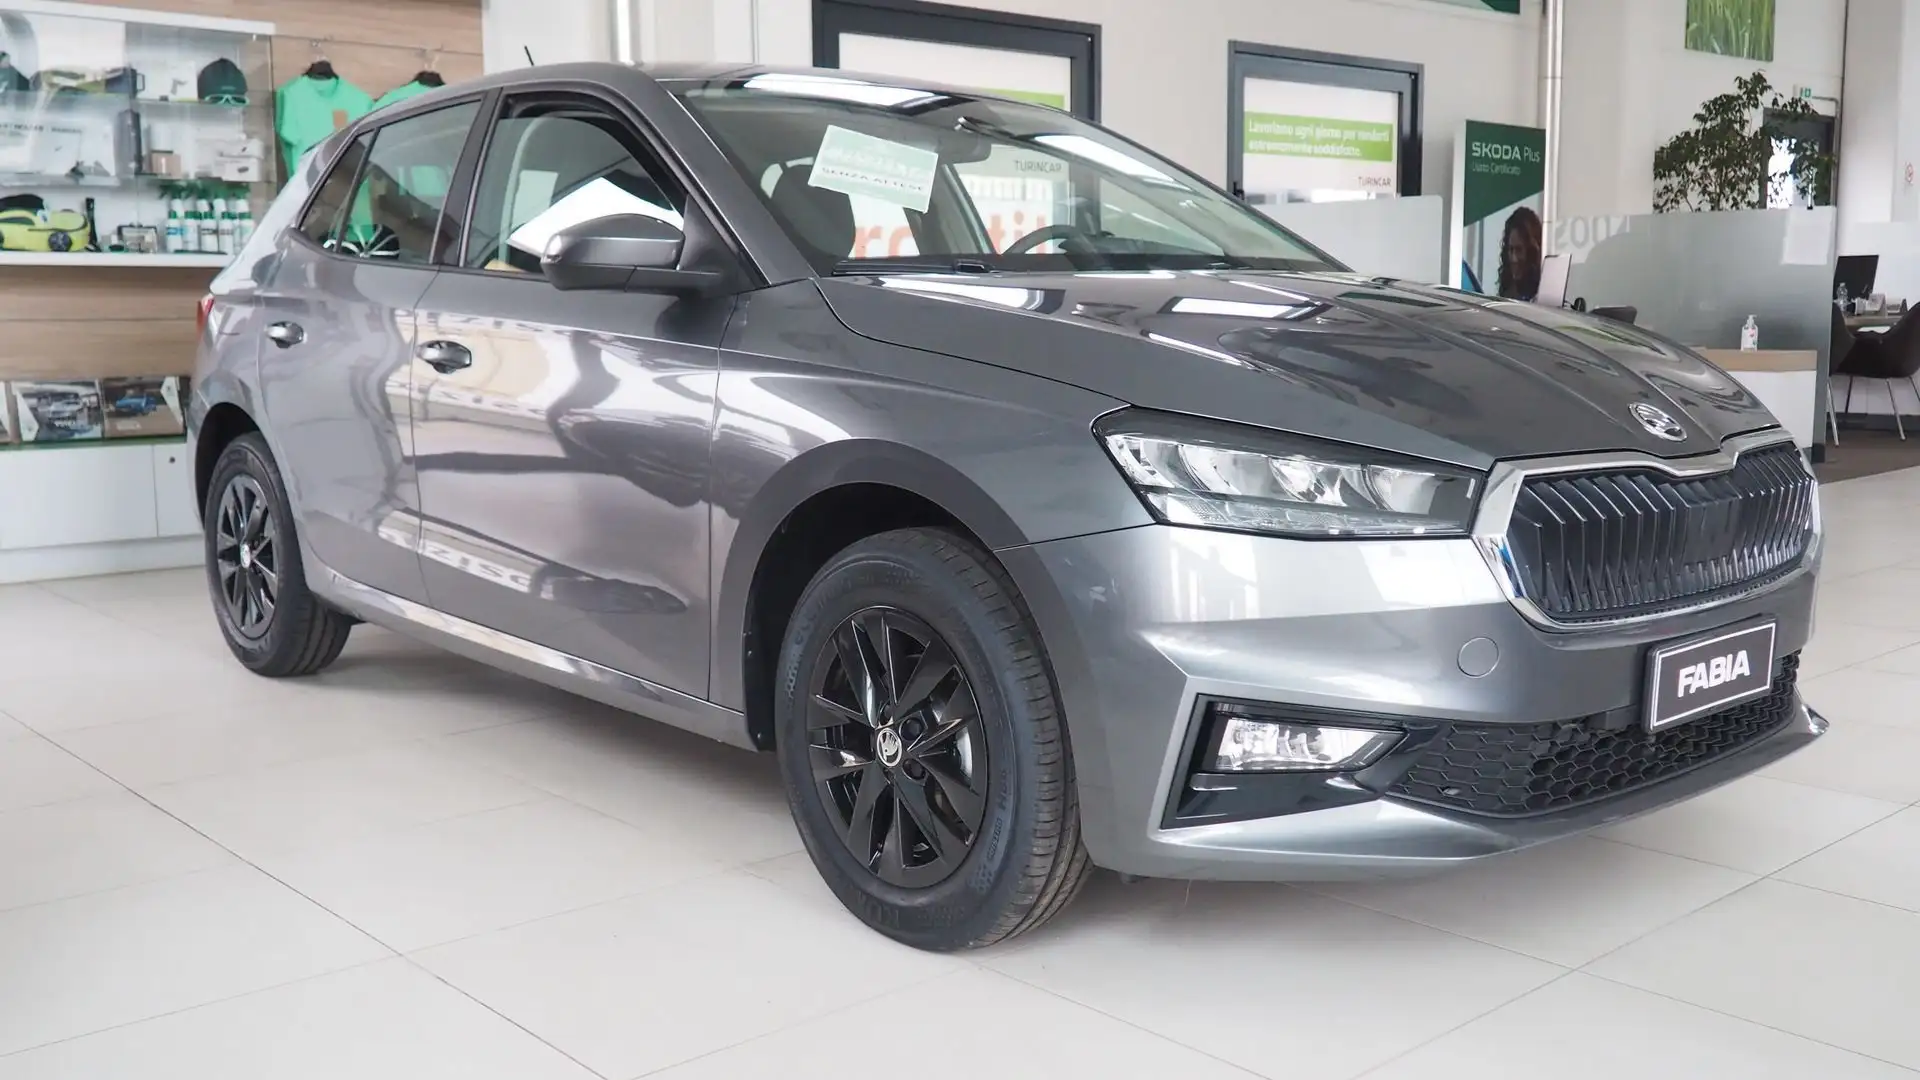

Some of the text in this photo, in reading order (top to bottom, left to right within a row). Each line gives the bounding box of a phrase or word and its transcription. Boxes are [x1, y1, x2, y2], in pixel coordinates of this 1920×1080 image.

[1523, 146, 1540, 163] Plus
[1014, 160, 1062, 173] TURINCAR
[1358, 176, 1391, 187] TURINCAR
[1677, 649, 1750, 698] FABIA
